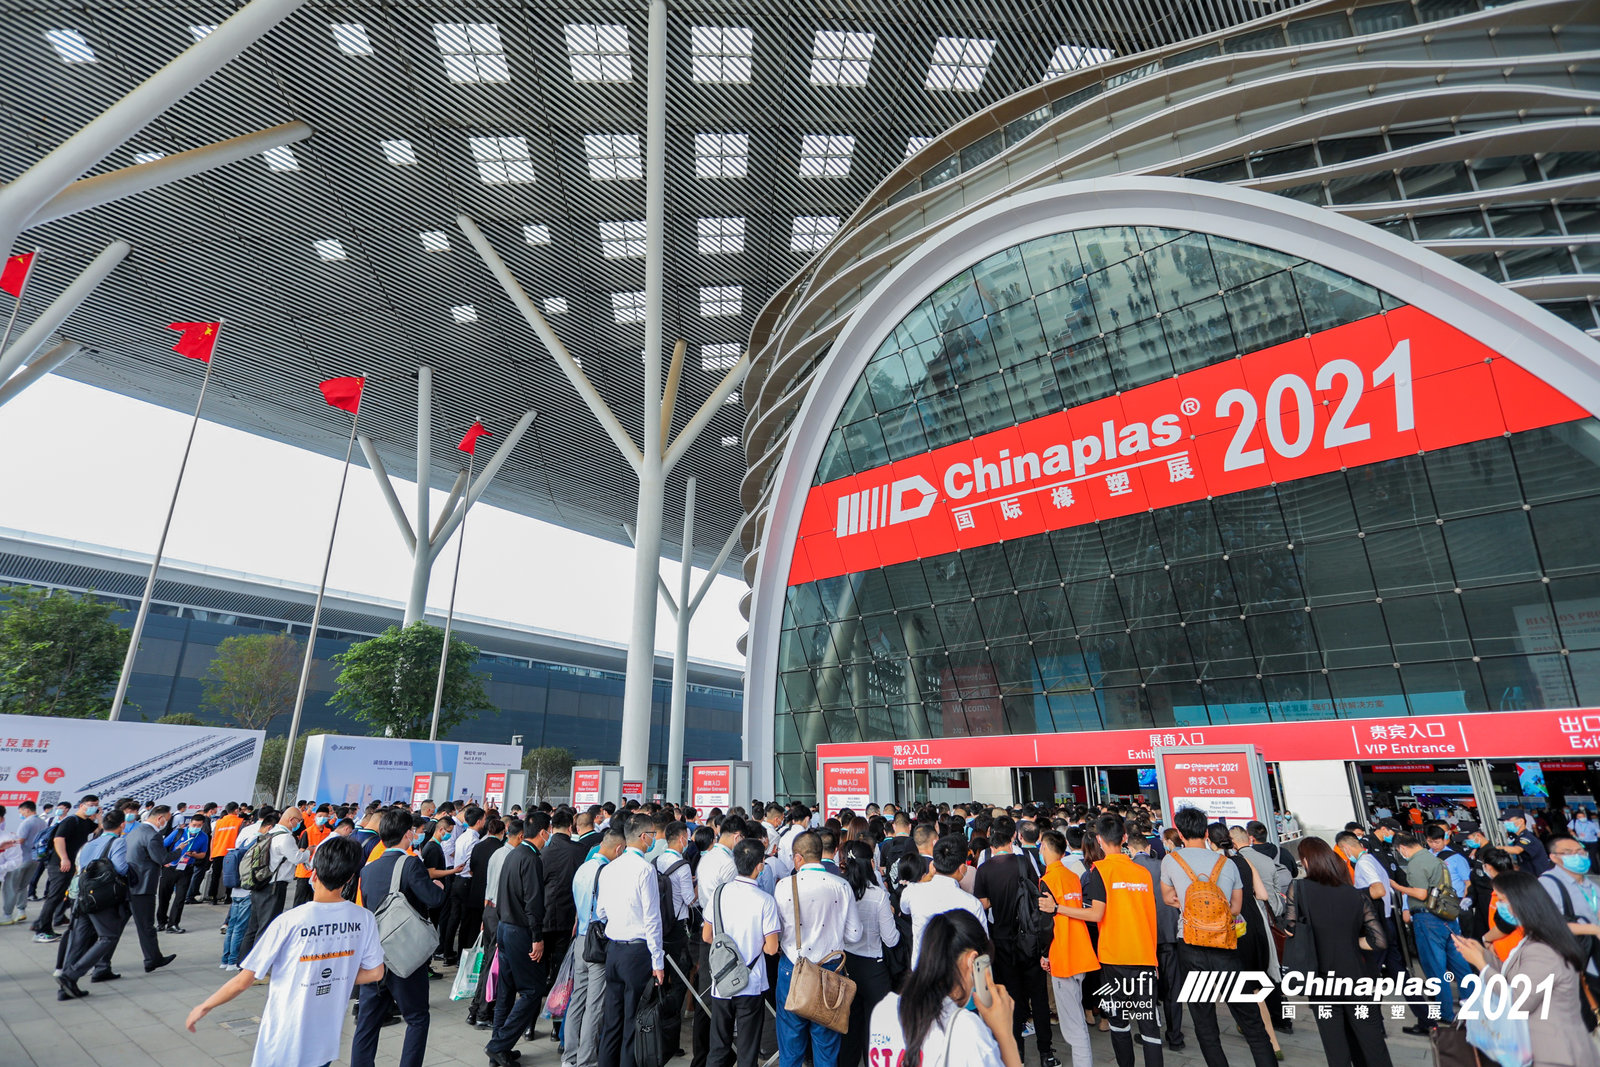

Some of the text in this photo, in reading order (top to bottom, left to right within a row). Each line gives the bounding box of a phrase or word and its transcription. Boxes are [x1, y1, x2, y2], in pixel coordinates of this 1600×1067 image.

[1215, 338, 1415, 472] 2021
[953, 456, 1195, 532] 国际橡塑展
[1370, 722, 1446, 740] 贵宾入口
[1149, 732, 1205, 747] 展商入口
[1569, 734, 1600, 749] Exi
[893, 744, 930, 756] 观众入口
[1364, 743, 1456, 755] VIP Entrance
[893, 756, 942, 766] itor Entrance
[1221, 763, 1239, 772] 2021
[1188, 776, 1228, 786] 贵宾入口
[1184, 786, 1236, 795] VIP Entrance
[300, 922, 361, 937] DAFTPUNK
